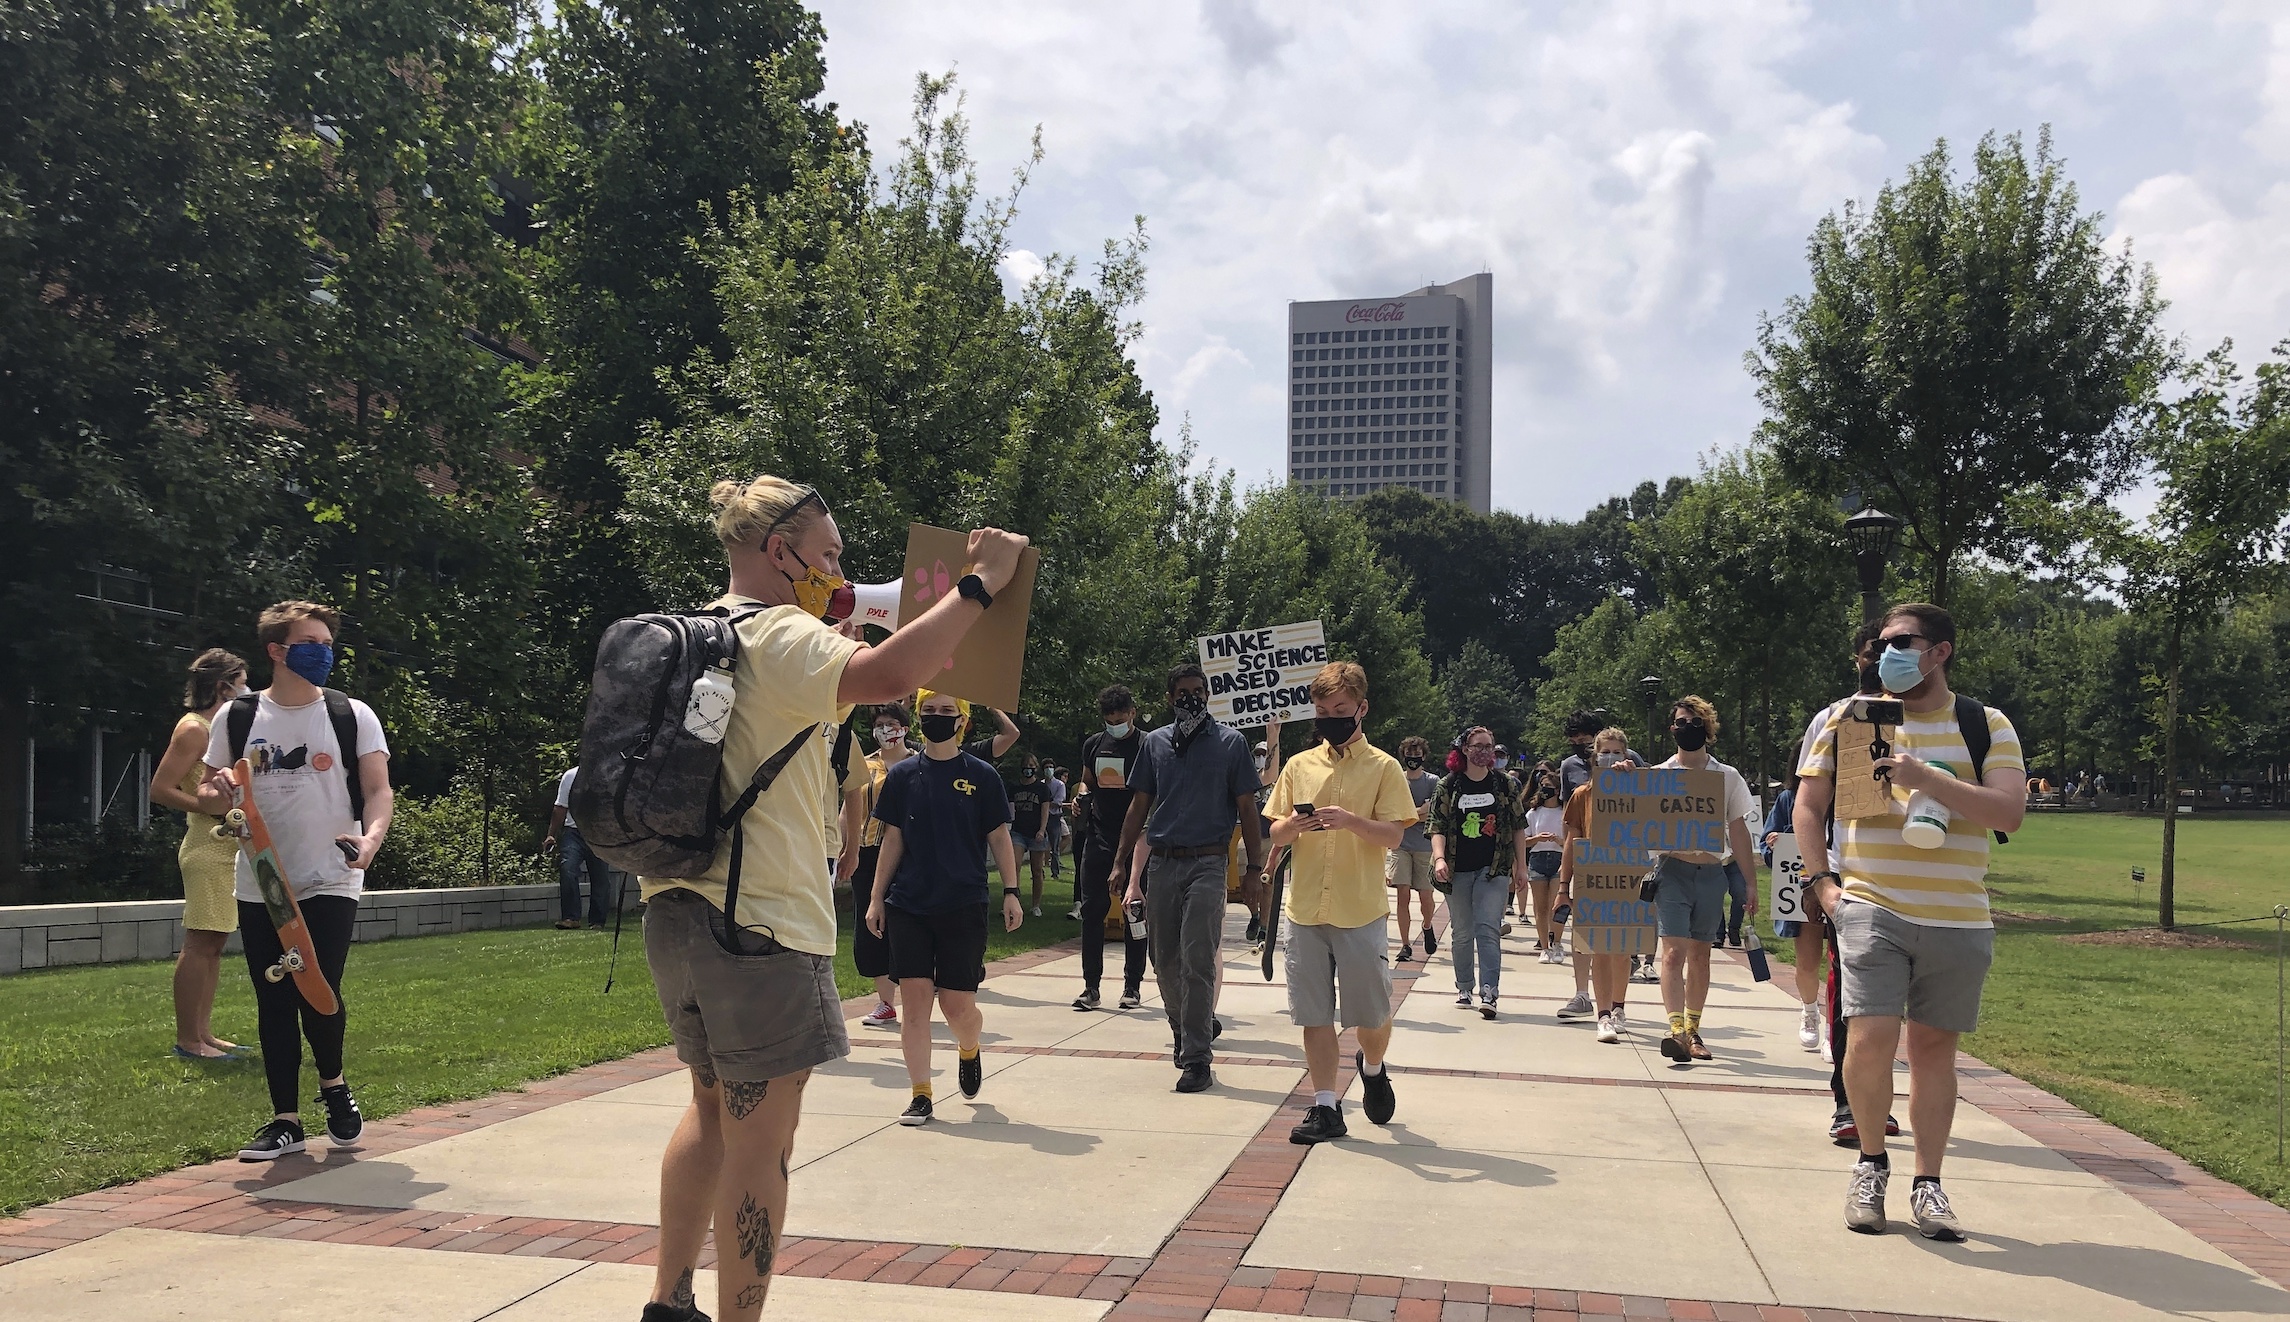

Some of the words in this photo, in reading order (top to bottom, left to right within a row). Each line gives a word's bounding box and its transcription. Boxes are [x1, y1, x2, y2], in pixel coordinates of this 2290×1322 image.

[1206, 630, 1274, 659] MAKE
[1237, 644, 1327, 672] SCIENCE
[1210, 669, 1280, 695] BASED
[952, 778, 977, 796] GT
[1600, 768, 1688, 796] ONLINE
[1660, 796, 1716, 814] CASES
[1609, 818, 1723, 852] DECLINE
[1586, 874, 1643, 890] BELIEV
[1576, 897, 1655, 925] SCIENCE
